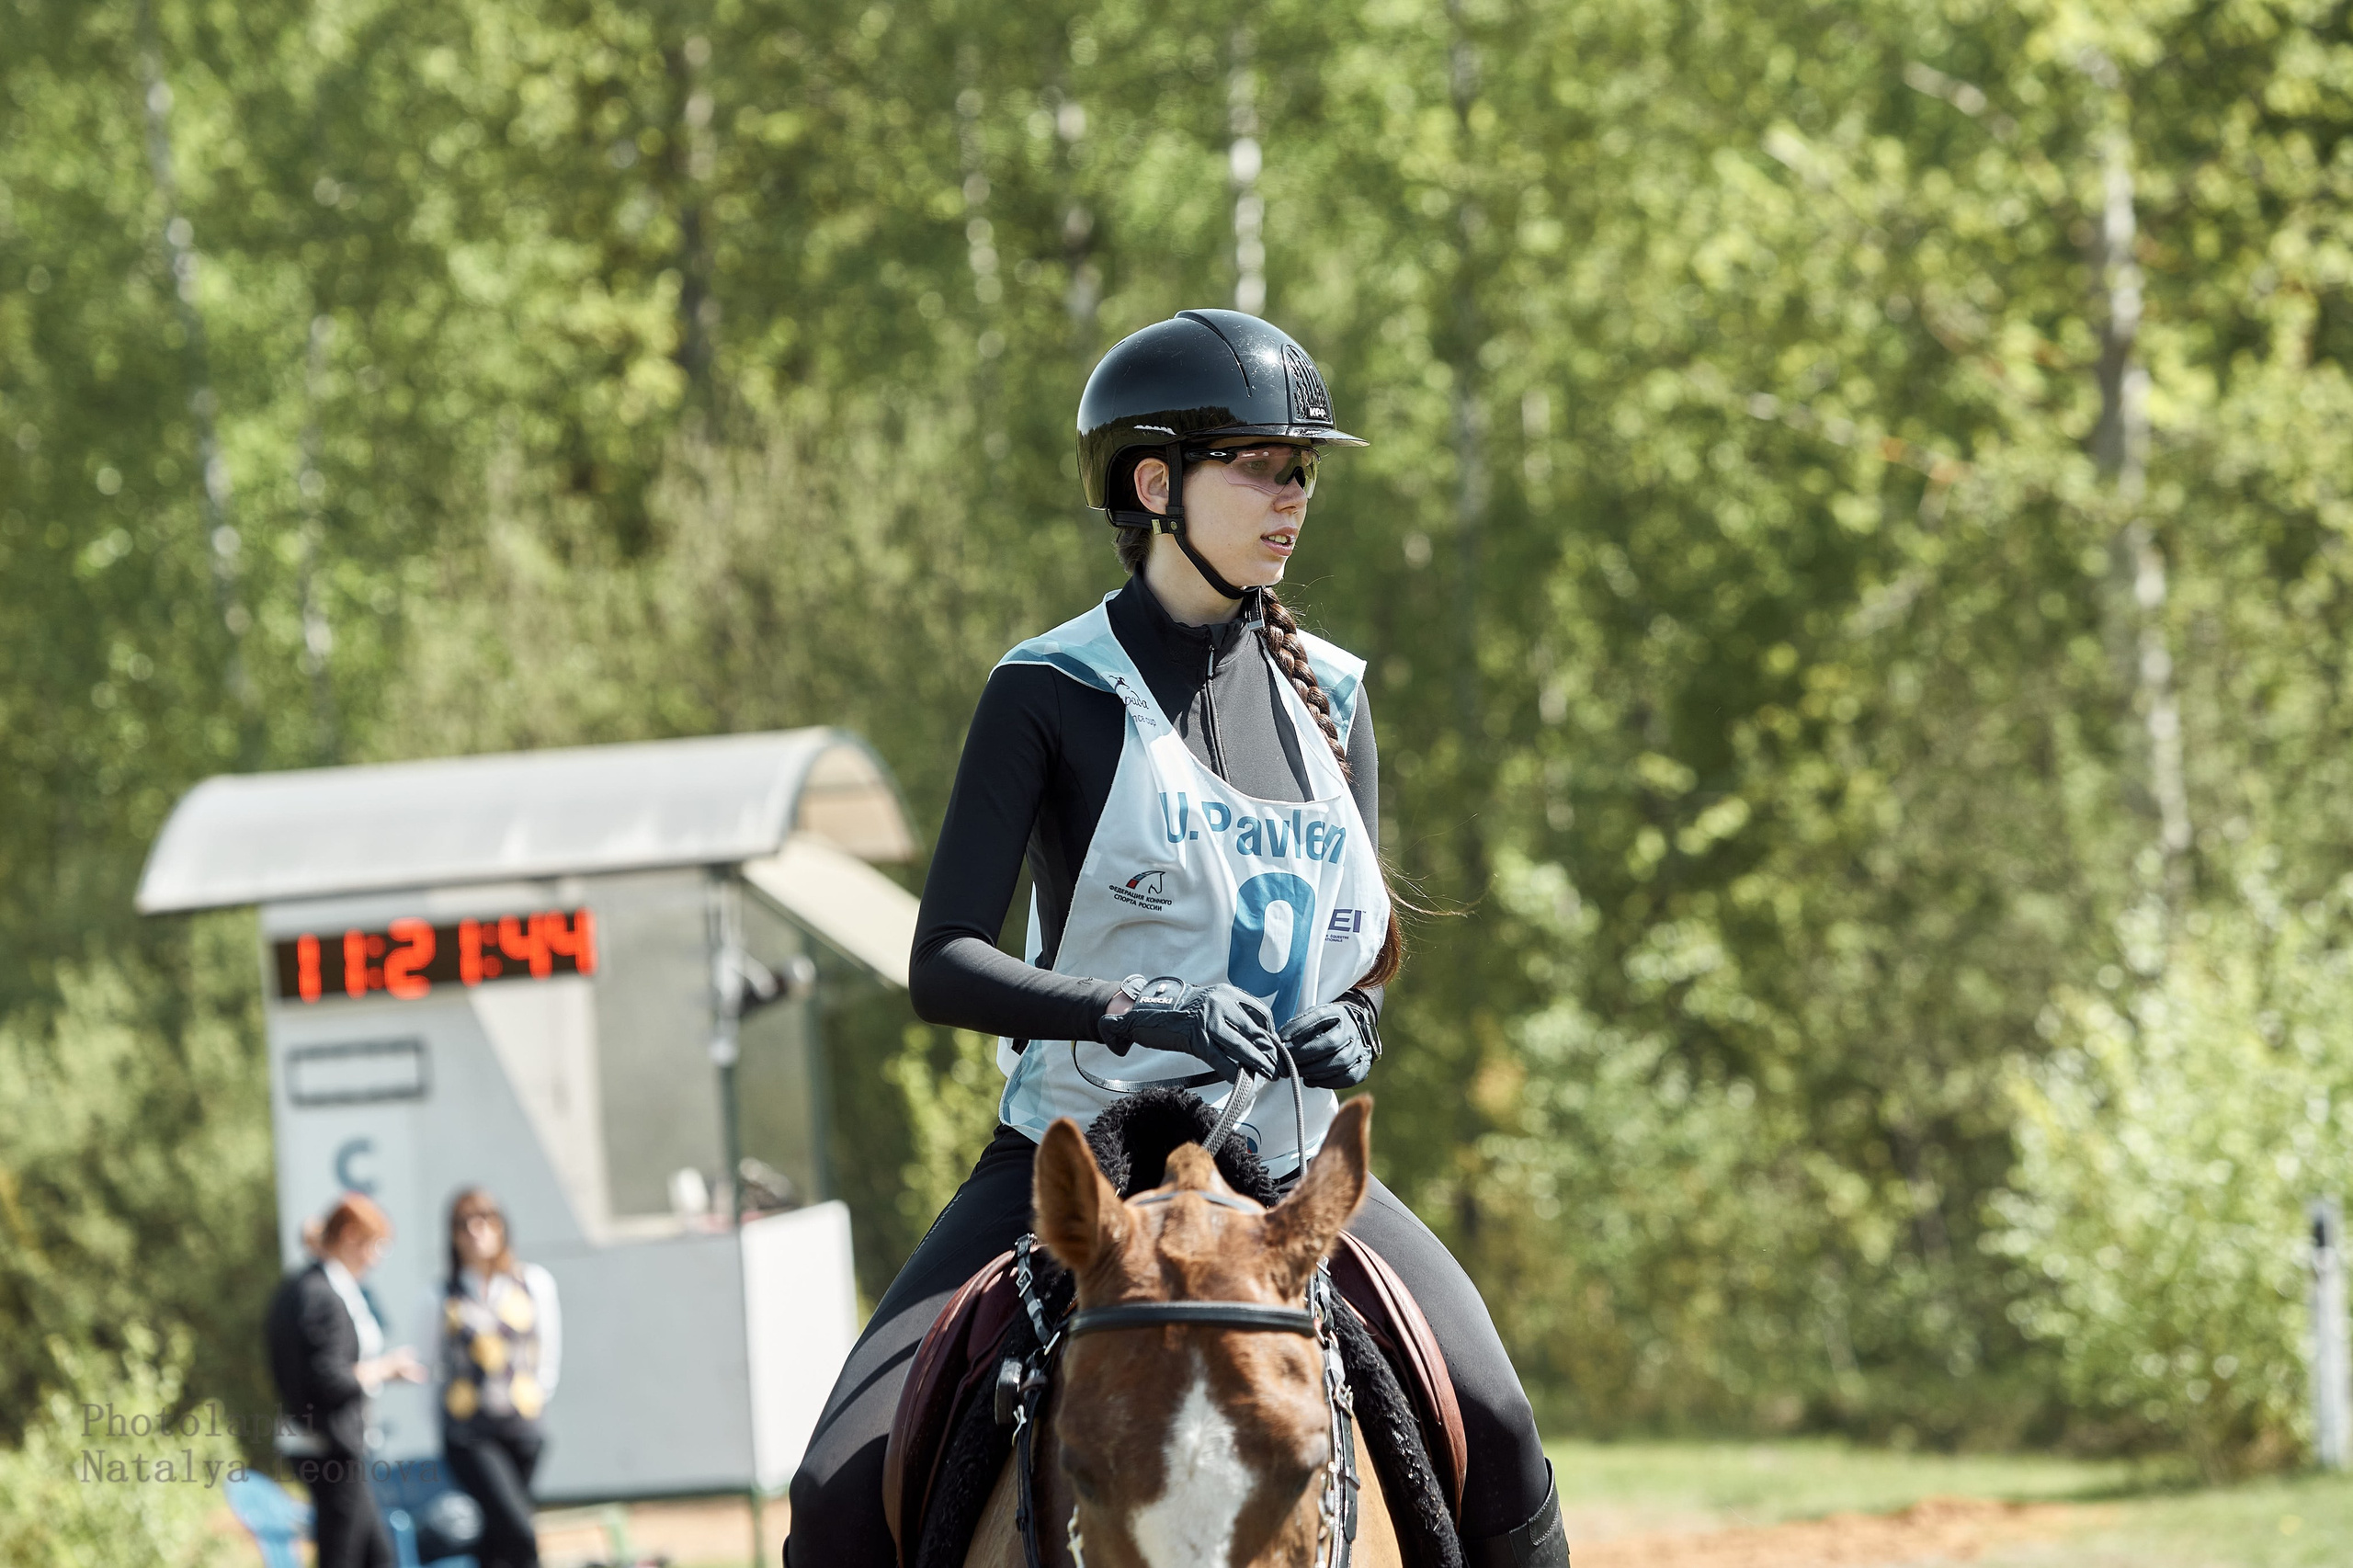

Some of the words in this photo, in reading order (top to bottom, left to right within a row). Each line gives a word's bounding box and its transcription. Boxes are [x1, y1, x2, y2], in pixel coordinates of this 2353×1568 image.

[1108, 884, 1145, 900] ФЕДЕРАЦИЯ
[1146, 896, 1173, 905] КОННОГО
[1113, 893, 1137, 906] СПОРТА
[1138, 902, 1163, 911] РОССИИ
[1327, 909, 1362, 933] EI
[297, 906, 597, 1004] 11:21:44
[1140, 996, 1174, 1005] Roeckl
